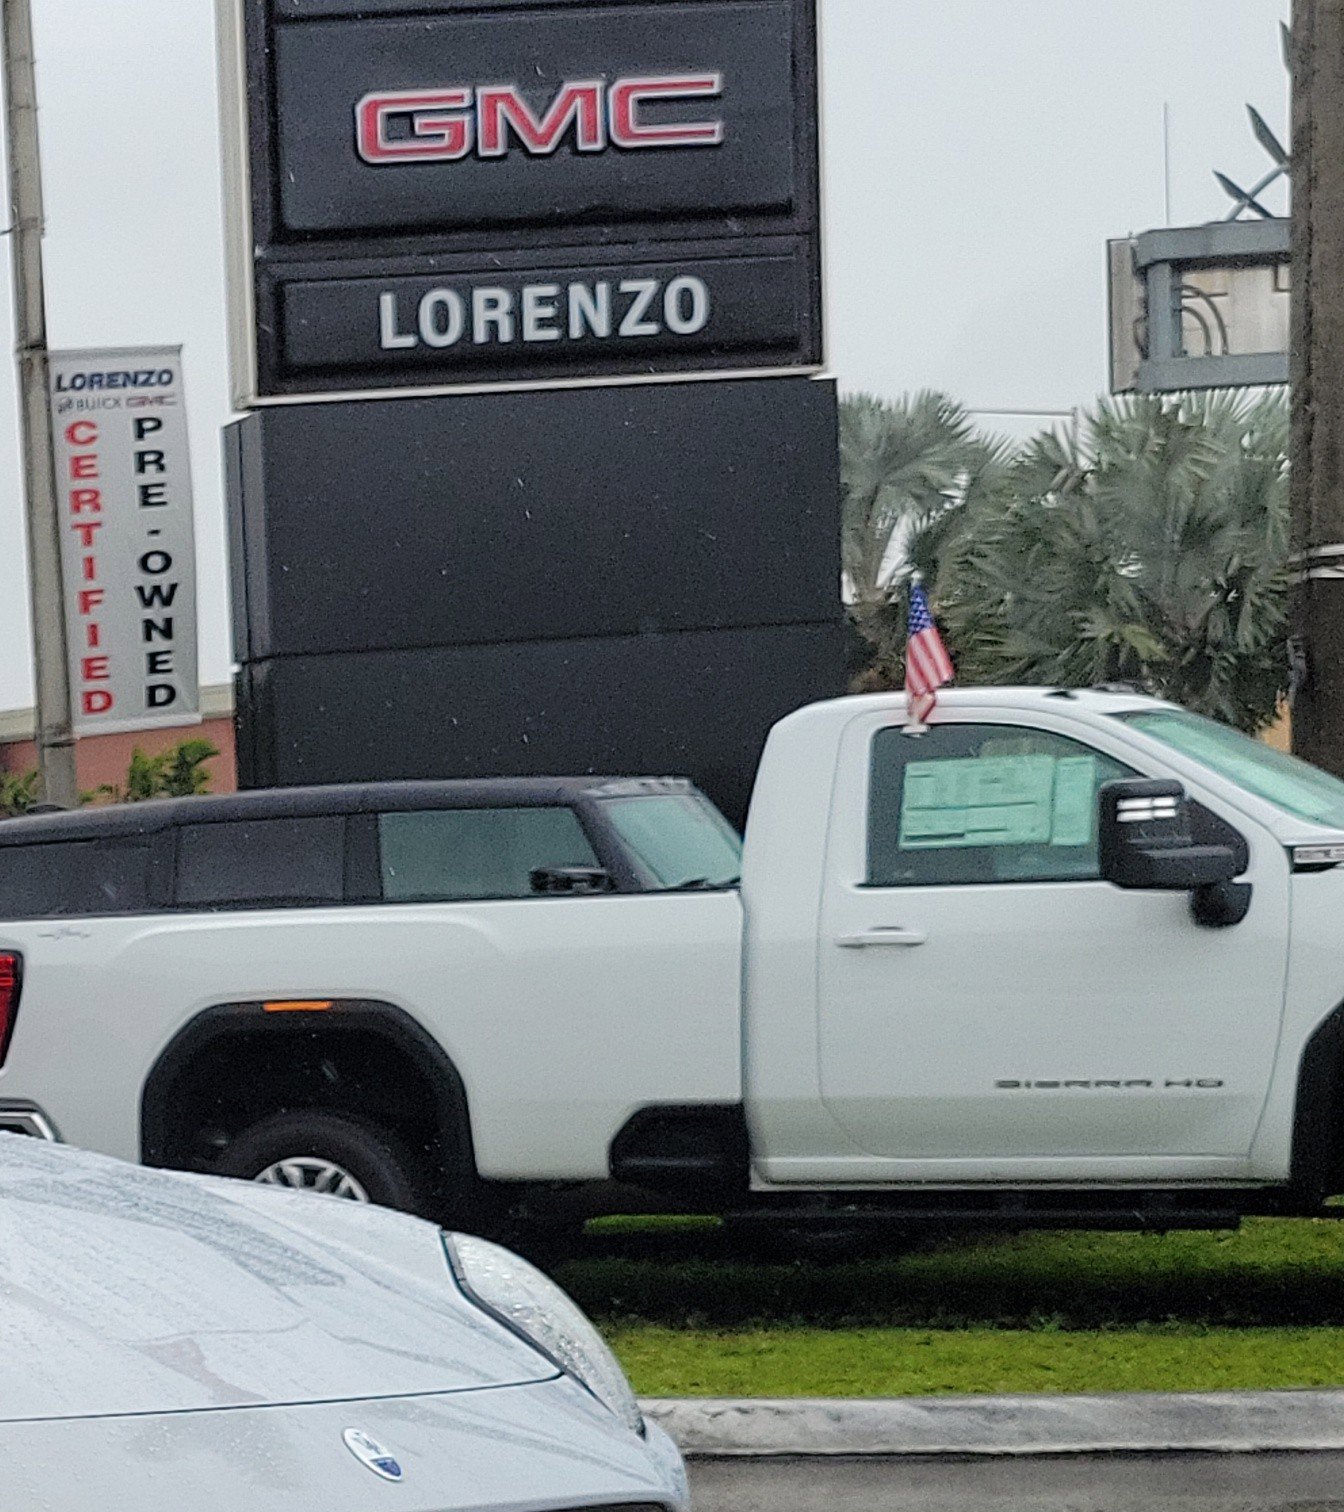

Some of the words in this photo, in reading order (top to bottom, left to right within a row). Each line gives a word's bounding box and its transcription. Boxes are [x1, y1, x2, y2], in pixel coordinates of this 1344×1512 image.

[355, 73, 724, 164] GMC
[379, 275, 710, 349] LORENZO
[55, 369, 174, 393] LORENZO
[64, 419, 114, 715] CERTIFIED
[133, 416, 179, 709] PRE-OWNED
